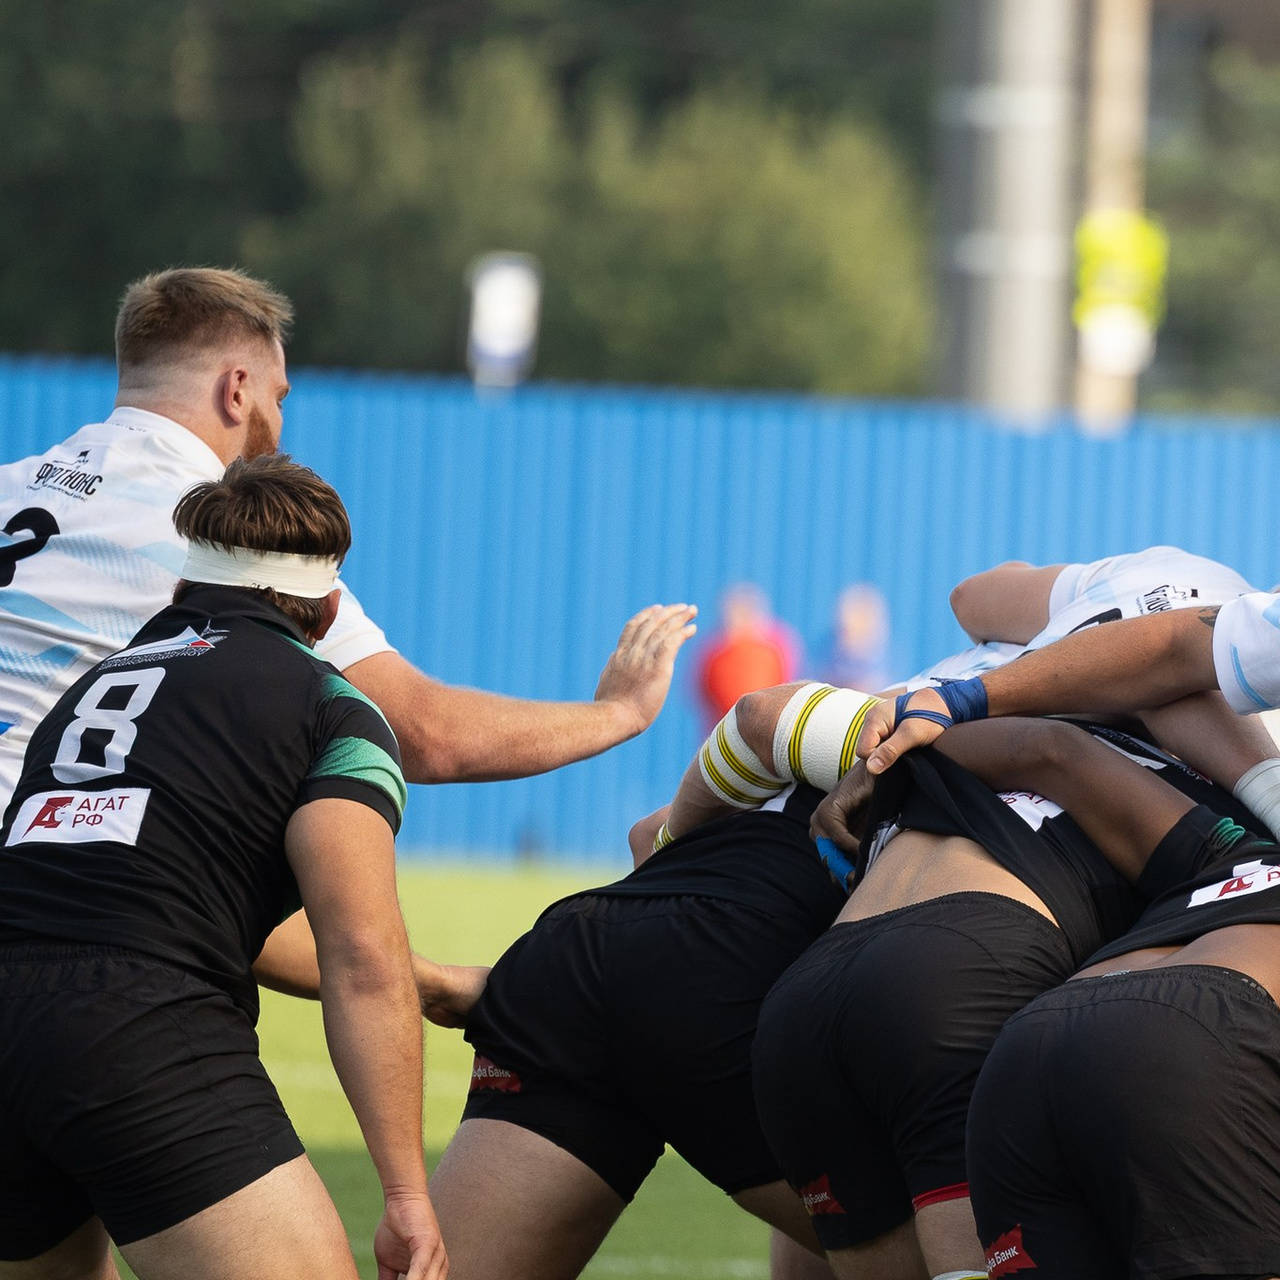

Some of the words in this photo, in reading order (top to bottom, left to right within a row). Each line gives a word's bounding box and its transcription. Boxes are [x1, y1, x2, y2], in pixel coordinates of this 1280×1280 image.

[50, 666, 166, 784] 8
[76, 796, 130, 812] АГАТ
[72, 813, 104, 828] РФ
[487, 1065, 511, 1078] Банк
[994, 1246, 1019, 1265] Банк
